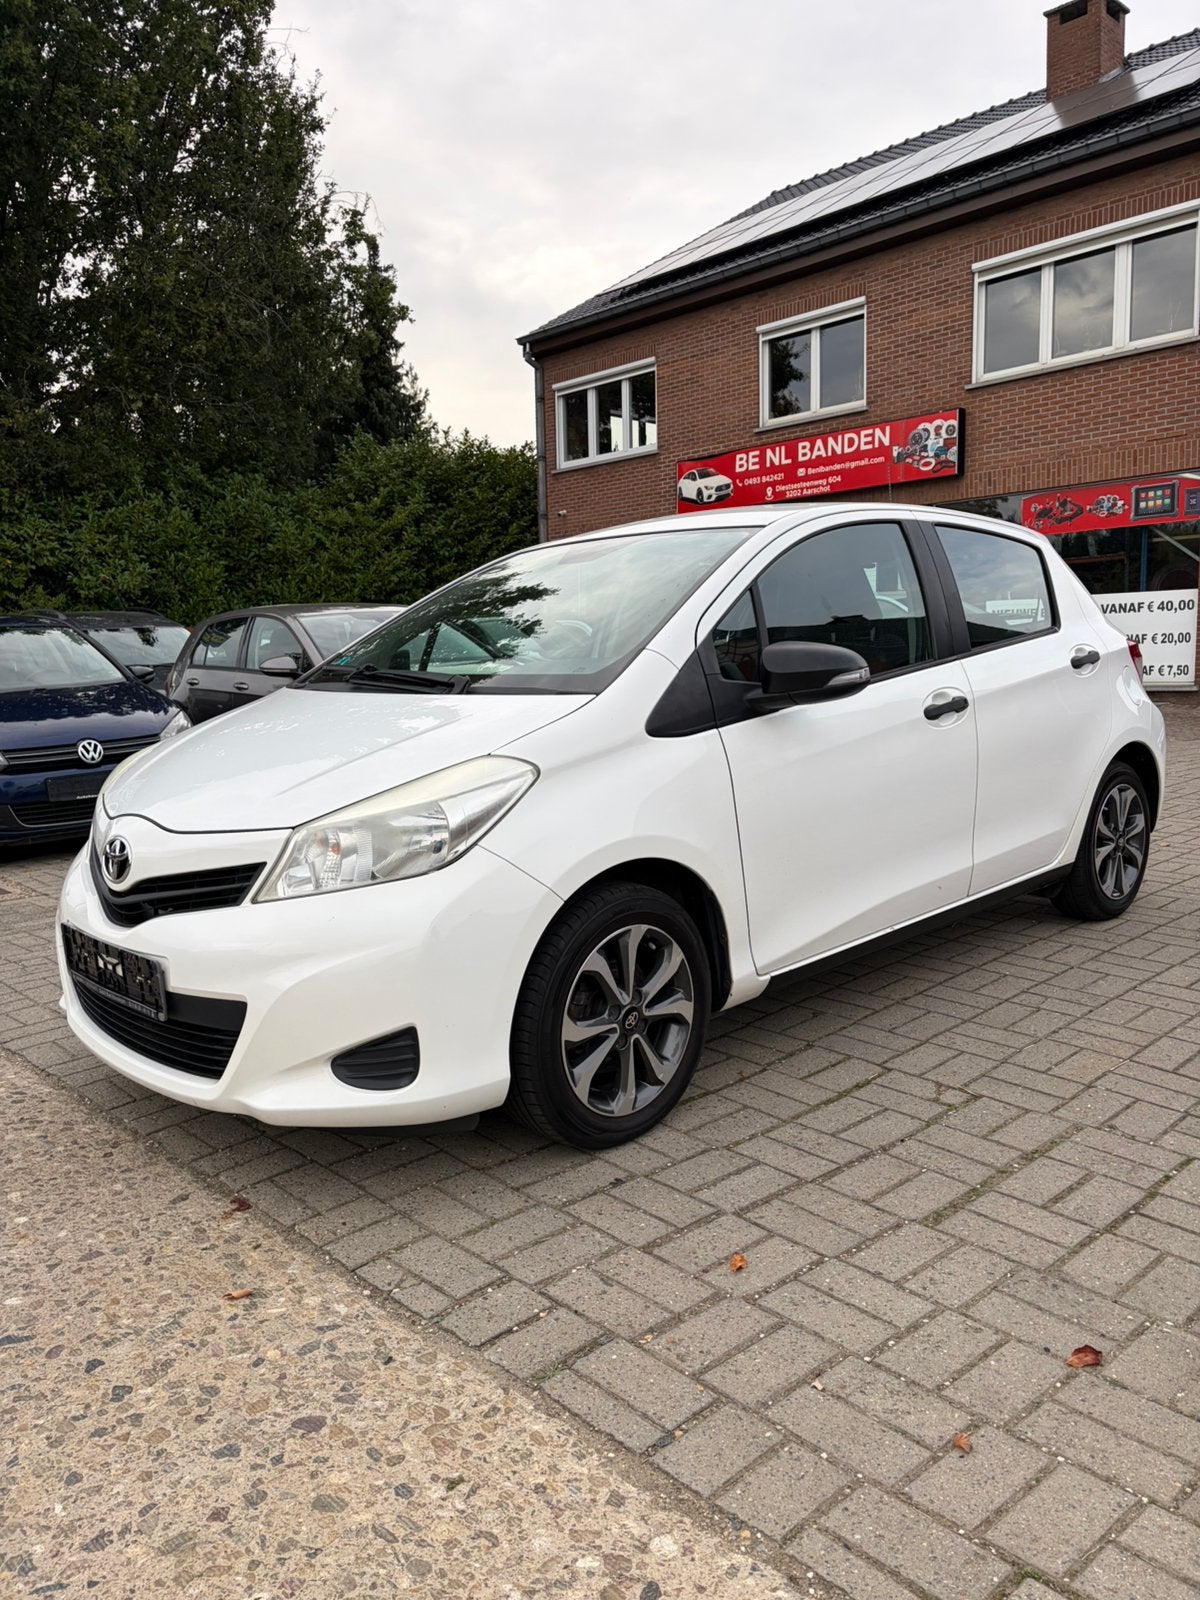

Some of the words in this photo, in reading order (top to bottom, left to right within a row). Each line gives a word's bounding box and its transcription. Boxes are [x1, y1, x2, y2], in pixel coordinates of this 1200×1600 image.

[735, 450, 760, 472] BE
[766, 445, 792, 468] NL
[797, 426, 890, 462] BANDEN
[744, 475, 761, 486] 0493
[828, 475, 841, 484] 604
[785, 488, 802, 498] 3202
[802, 485, 831, 496] Aarschot
[1101, 602, 1145, 614] VANAF
[1147, 601, 1155, 613] €
[1157, 599, 1195, 613] 40,00
[1151, 633, 1159, 645] €
[1160, 632, 1191, 646] 20,00
[1158, 665, 1165, 676] €
[1167, 664, 1189, 678] 7,50
